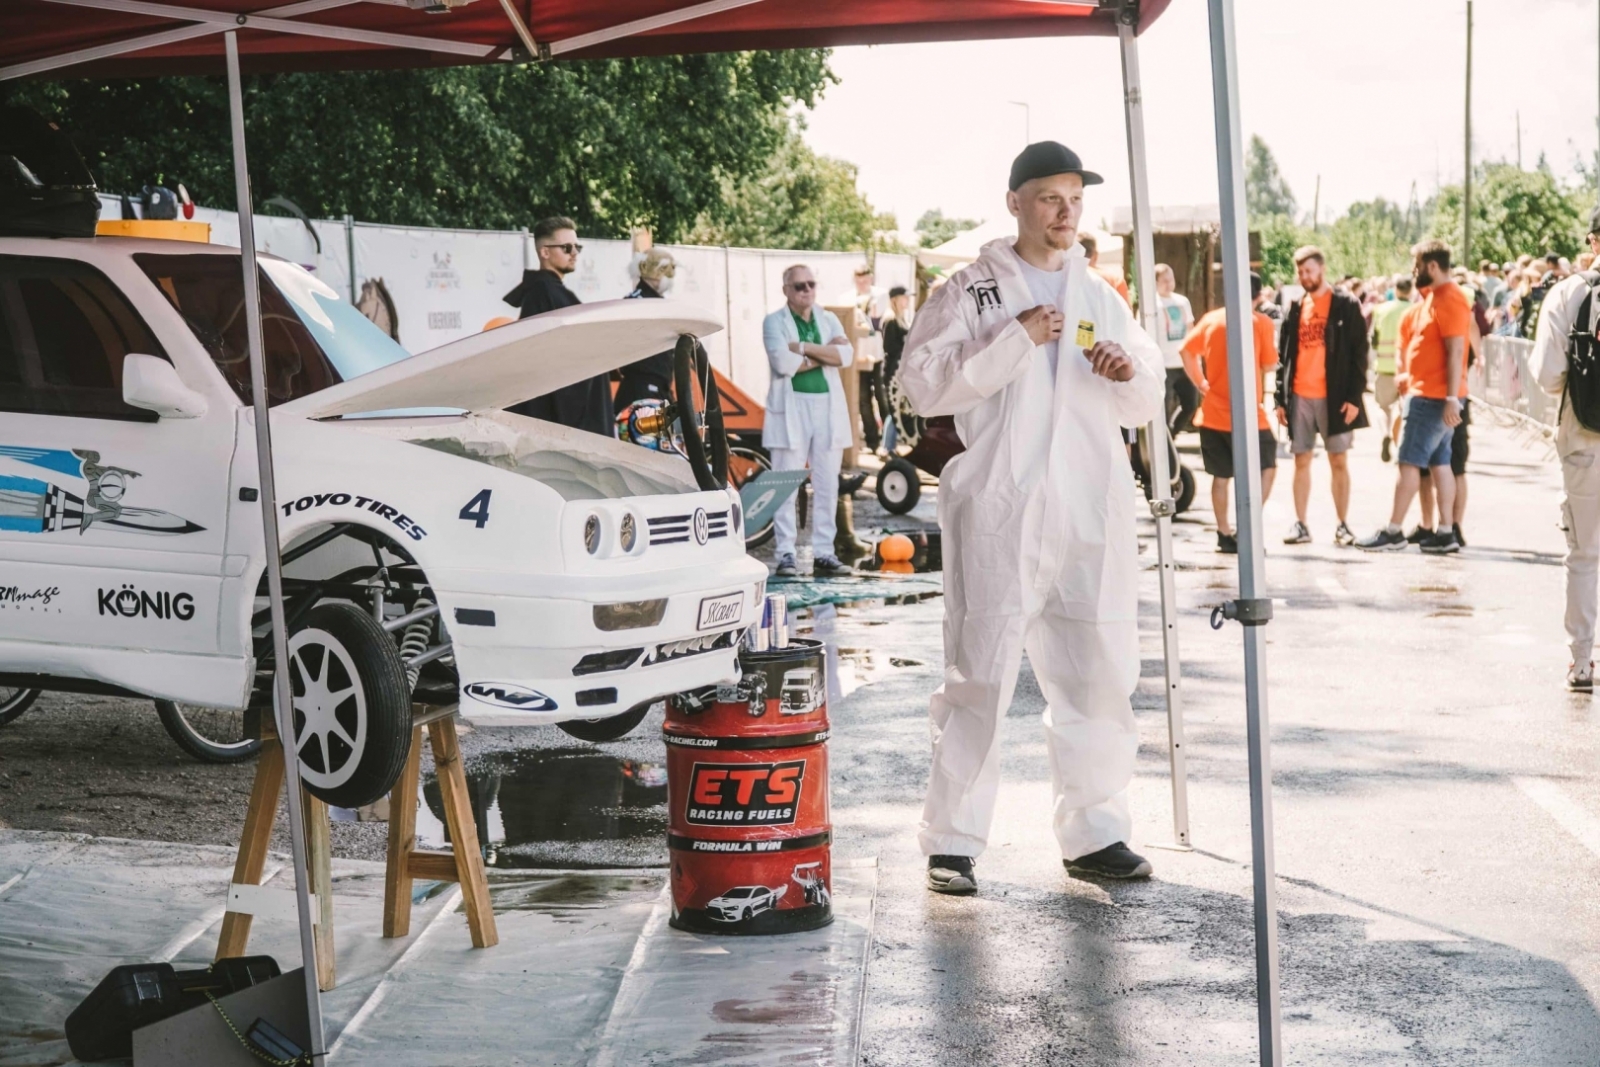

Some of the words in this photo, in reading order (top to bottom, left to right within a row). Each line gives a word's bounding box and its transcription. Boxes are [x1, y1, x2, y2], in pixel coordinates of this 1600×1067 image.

[281, 493, 352, 517] TOYO
[354, 496, 428, 541] TIRES
[459, 489, 492, 529] 4
[98, 584, 195, 621] KÖNIG
[694, 767, 800, 805] ETS
[748, 808, 792, 820] FUELS
[693, 841, 752, 852] FORMULA
